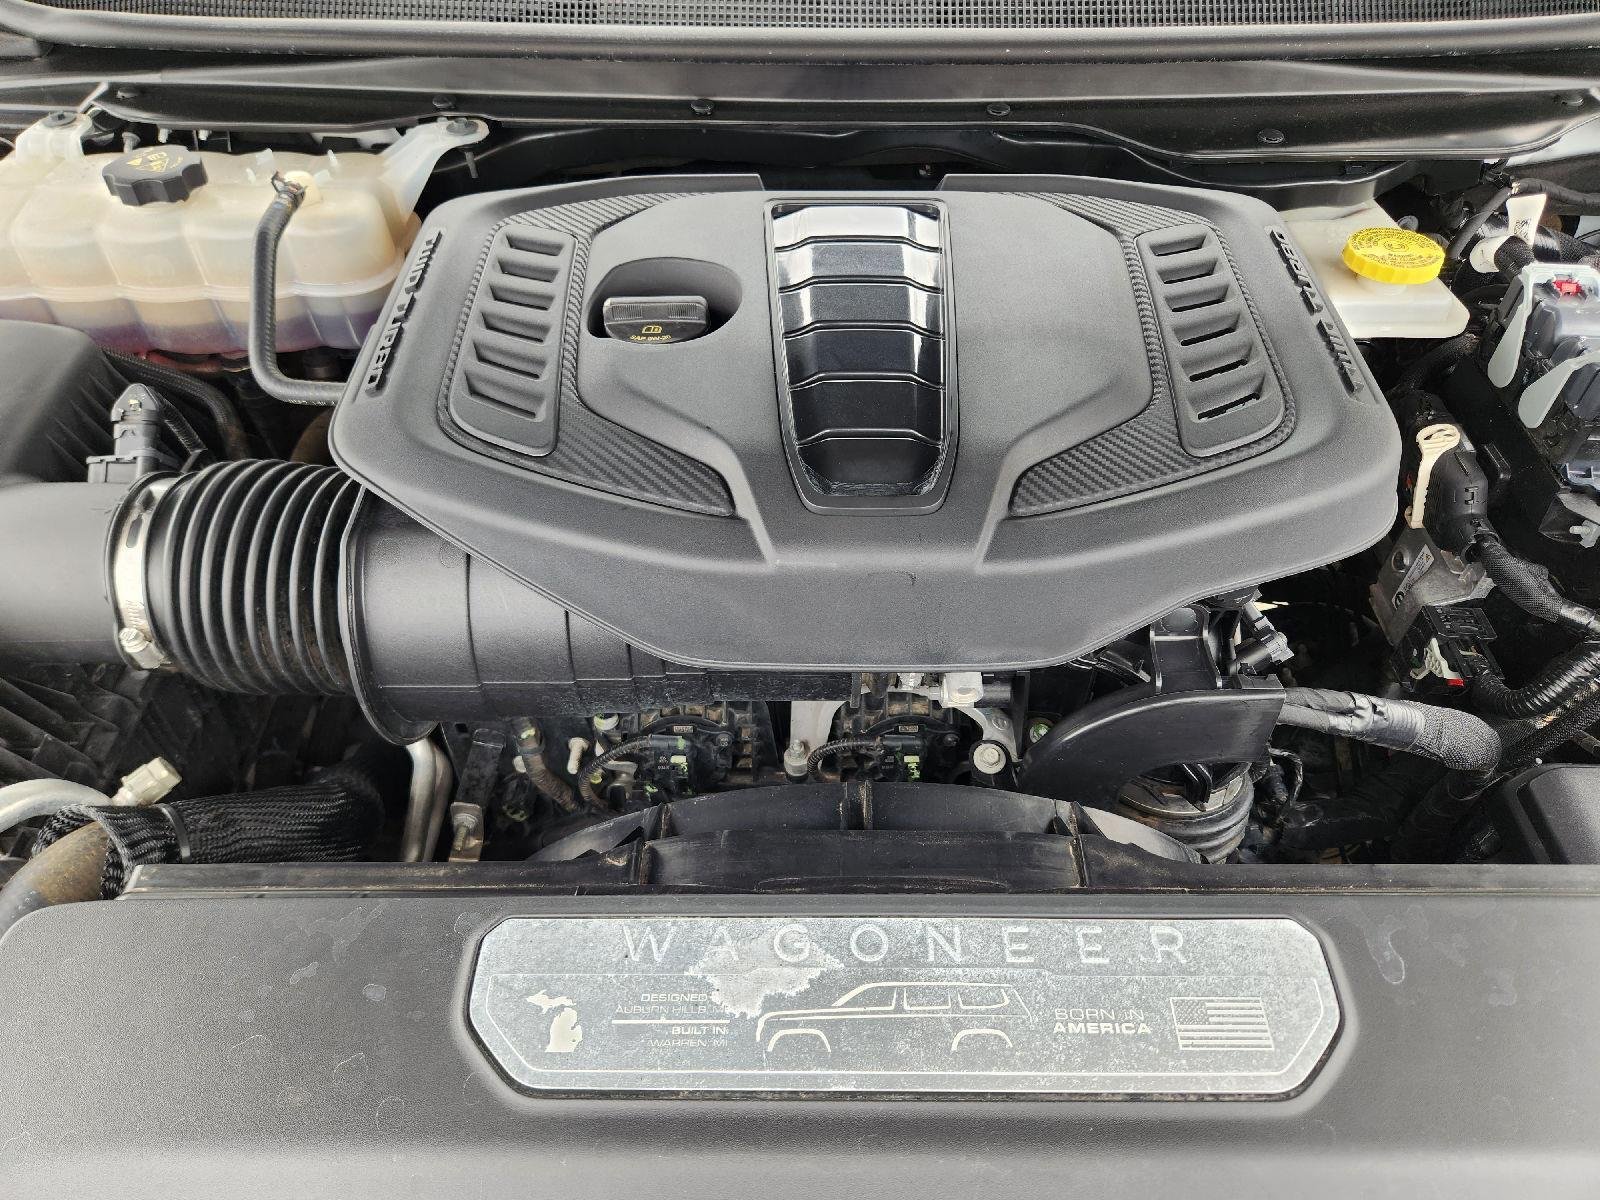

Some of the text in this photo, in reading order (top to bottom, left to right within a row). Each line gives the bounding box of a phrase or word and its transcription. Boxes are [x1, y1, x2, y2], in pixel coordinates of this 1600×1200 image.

[365, 291, 416, 397] TURBO
[622, 922, 1188, 964] WAGONEER
[640, 993, 708, 1002] DESIGNED
[615, 1004, 669, 1014] AUBURN
[1053, 1008, 1145, 1021] BORN IN
[671, 1026, 709, 1035] BUILT
[1052, 1021, 1152, 1035] AMERICA
